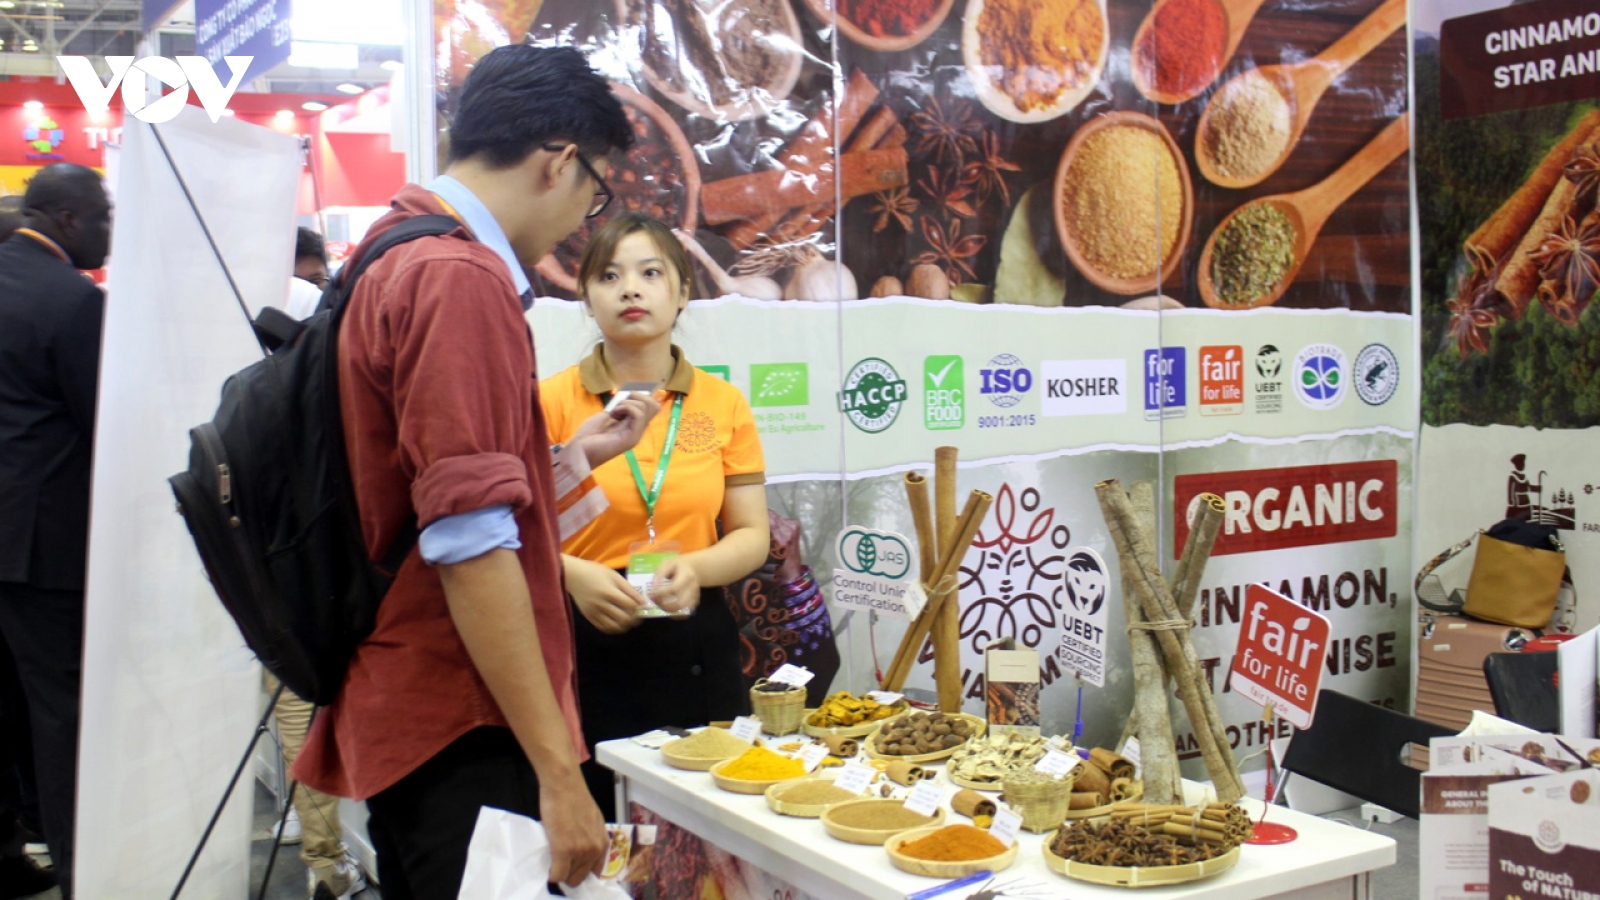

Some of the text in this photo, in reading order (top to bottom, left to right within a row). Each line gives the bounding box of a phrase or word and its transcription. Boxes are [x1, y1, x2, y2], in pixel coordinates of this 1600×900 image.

[1485, 12, 1600, 55] CINNAMO
[1494, 58, 1556, 89] STAR
[1148, 354, 1175, 378] for
[1201, 349, 1241, 381] fair
[979, 368, 1033, 394] ISO
[1047, 377, 1120, 399] KOSHER
[1149, 380, 1176, 405] life
[1202, 384, 1241, 400] for life
[1255, 382, 1282, 392] UEBT
[841, 383, 906, 409] HACCP
[926, 389, 962, 406] BRC
[927, 405, 962, 422] FOOD
[978, 414, 1036, 428] 9001:2015
[879, 551, 905, 565] JAS
[833, 574, 877, 593] Control
[835, 589, 908, 613] Certification
[1192, 567, 1398, 628] INMON,
[1063, 613, 1103, 644] UEBT
[1248, 601, 1319, 669] fair
[1062, 634, 1102, 659] CERTIFIED
[1326, 631, 1396, 676] NISE
[1060, 649, 1101, 675] SOURCING
[1242, 648, 1272, 680] for
[1275, 666, 1308, 701] life
[1250, 685, 1266, 700] fair
[1175, 717, 1291, 752] AN OTHE
[1444, 800, 1474, 808] ABOUT
[1499, 859, 1574, 888] The Touch
[1522, 880, 1539, 894] of
